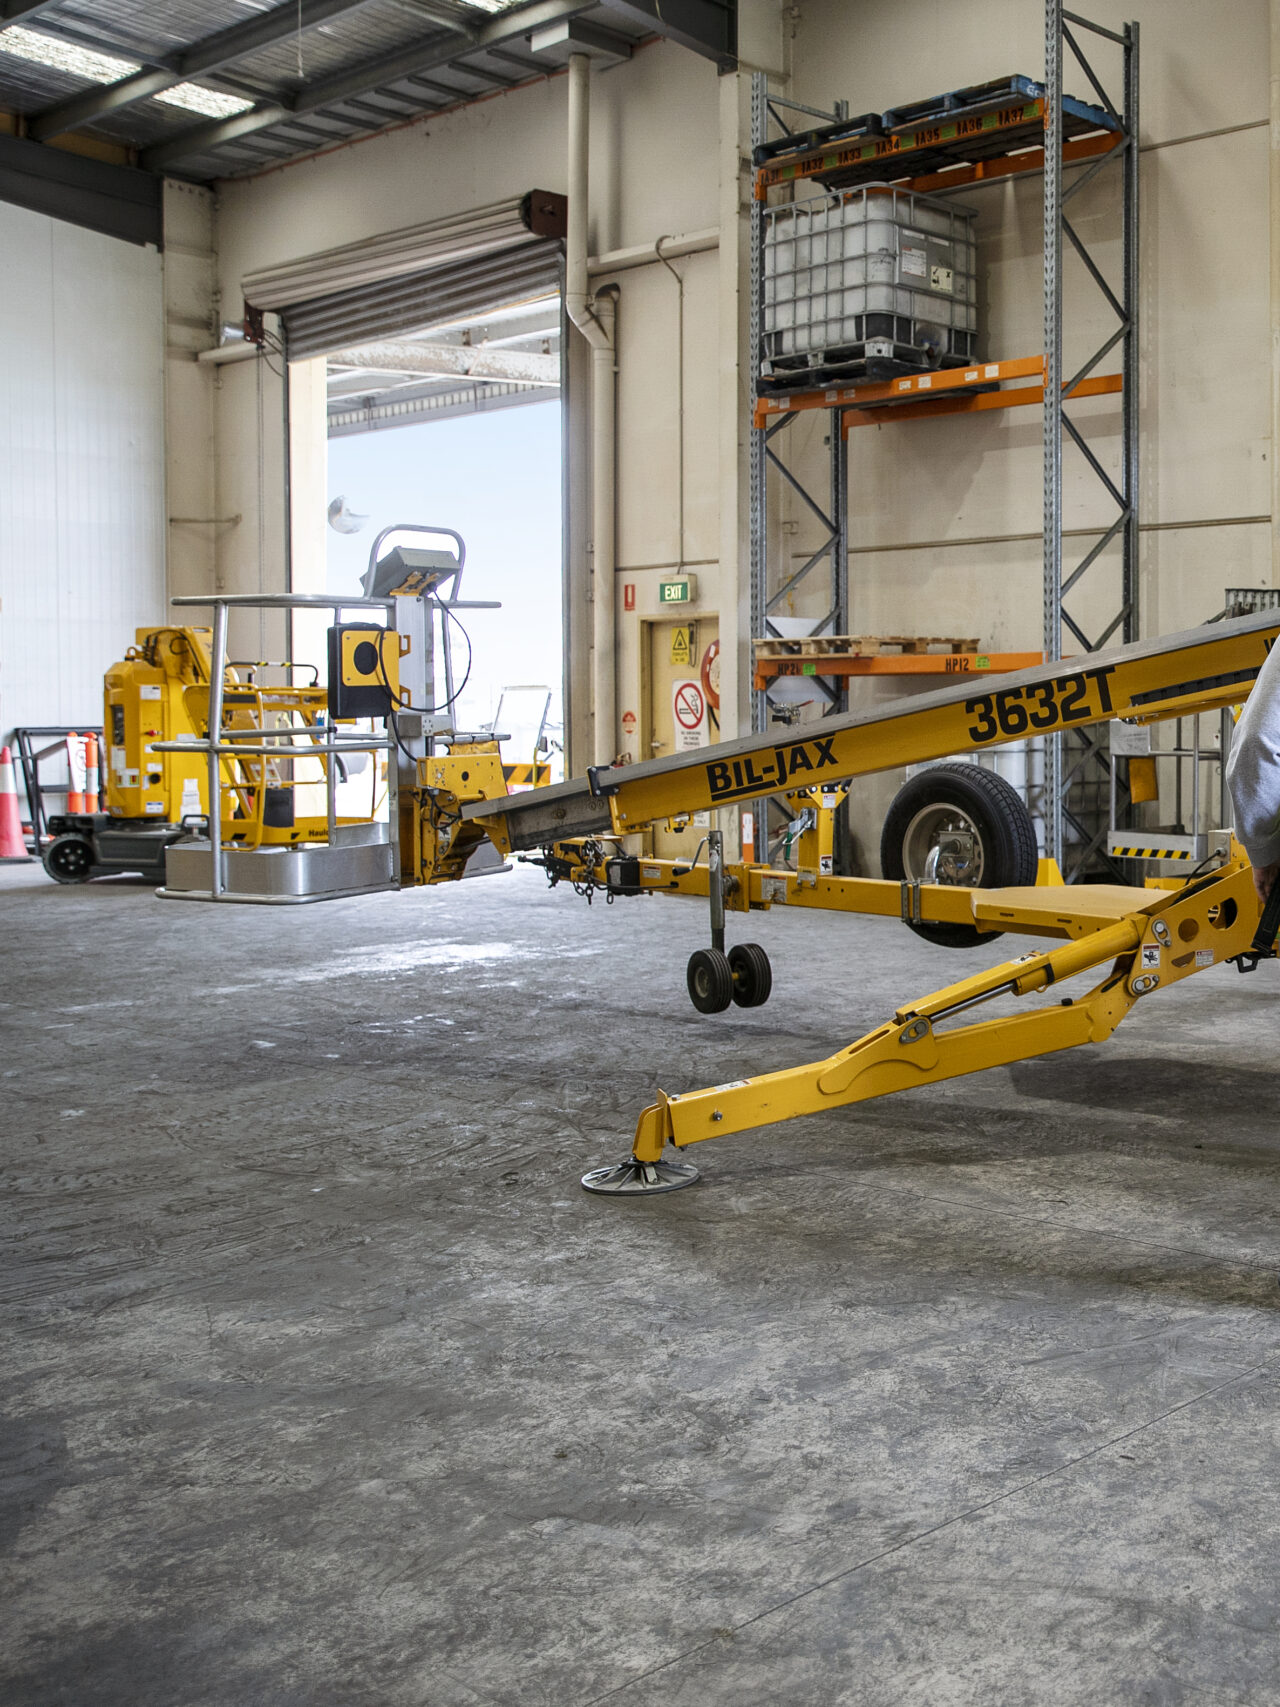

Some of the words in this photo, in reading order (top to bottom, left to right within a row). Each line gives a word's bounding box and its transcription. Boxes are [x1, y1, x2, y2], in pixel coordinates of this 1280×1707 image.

[664, 584, 683, 600] EXIT
[945, 657, 969, 672] HP12
[966, 667, 1116, 743] 3632T
[706, 735, 839, 797] BIL-JAX
